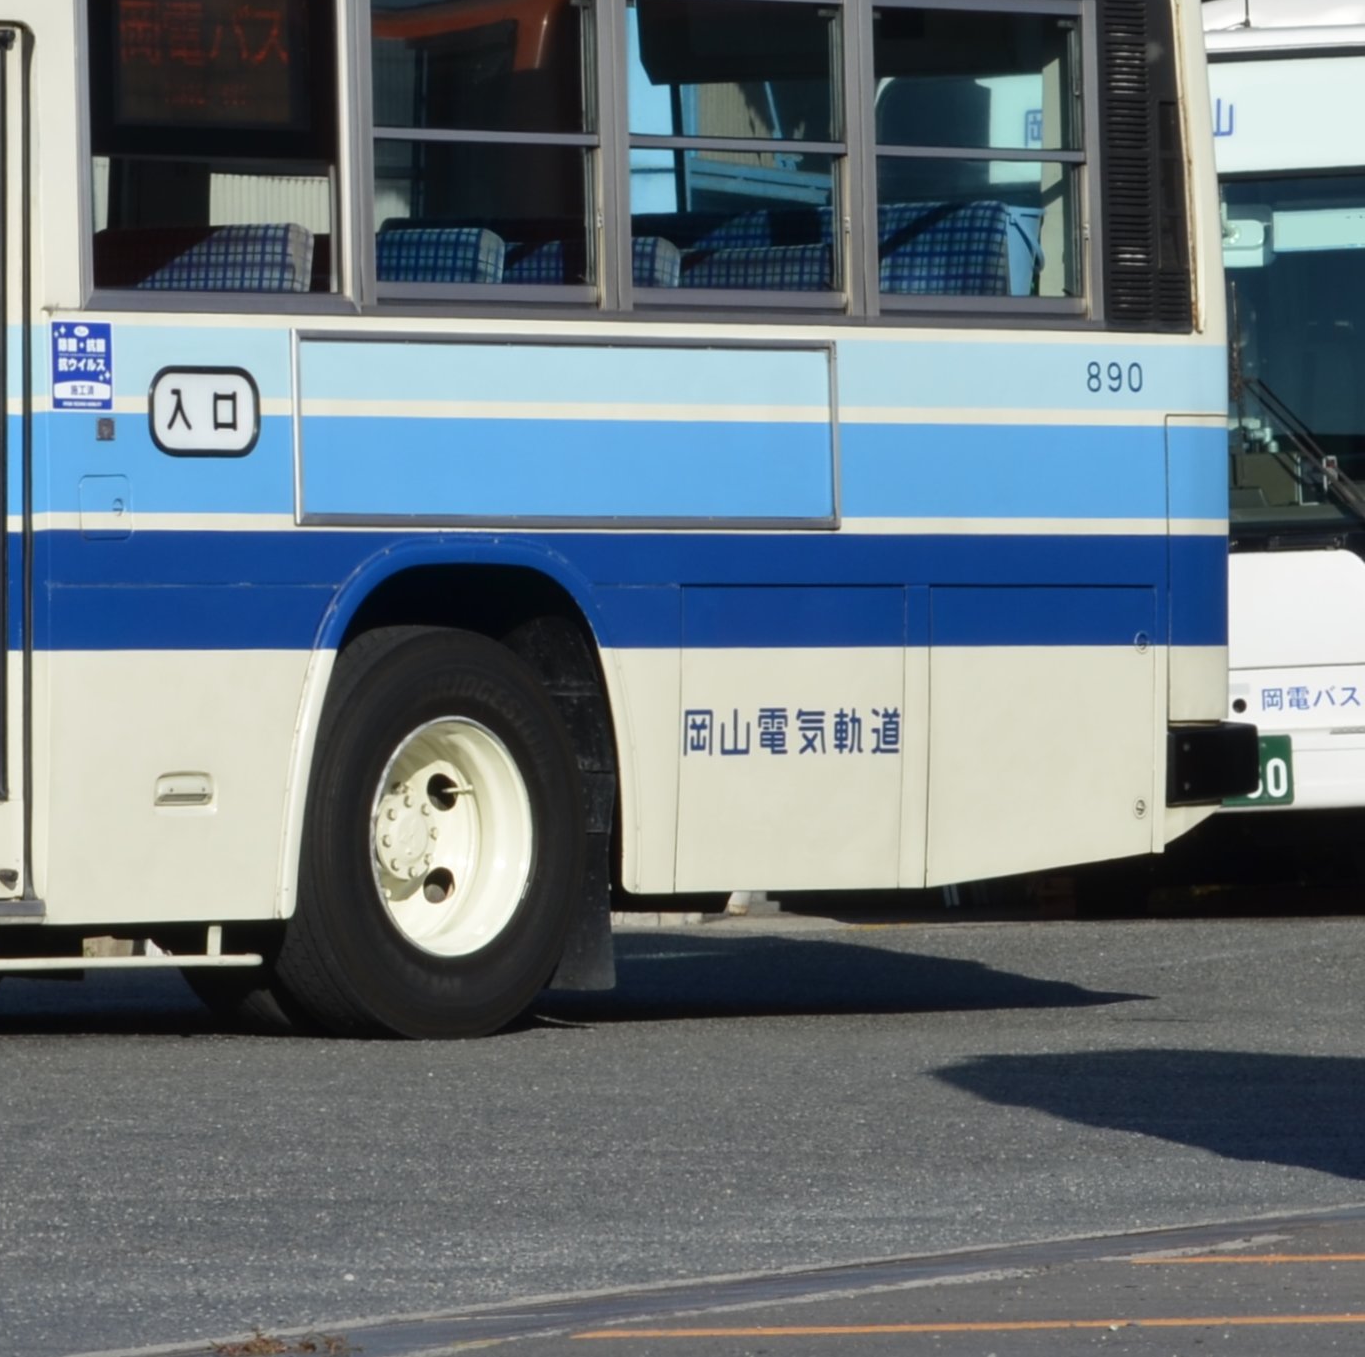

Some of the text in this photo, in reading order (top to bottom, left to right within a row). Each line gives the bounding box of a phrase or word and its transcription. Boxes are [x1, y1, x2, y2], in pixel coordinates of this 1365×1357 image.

[1087, 361, 1143, 393] 890
[167, 388, 237, 432] 入口
[1261, 685, 1361, 711] 岡電バス
[683, 707, 901, 757] 岡山電気軌道
